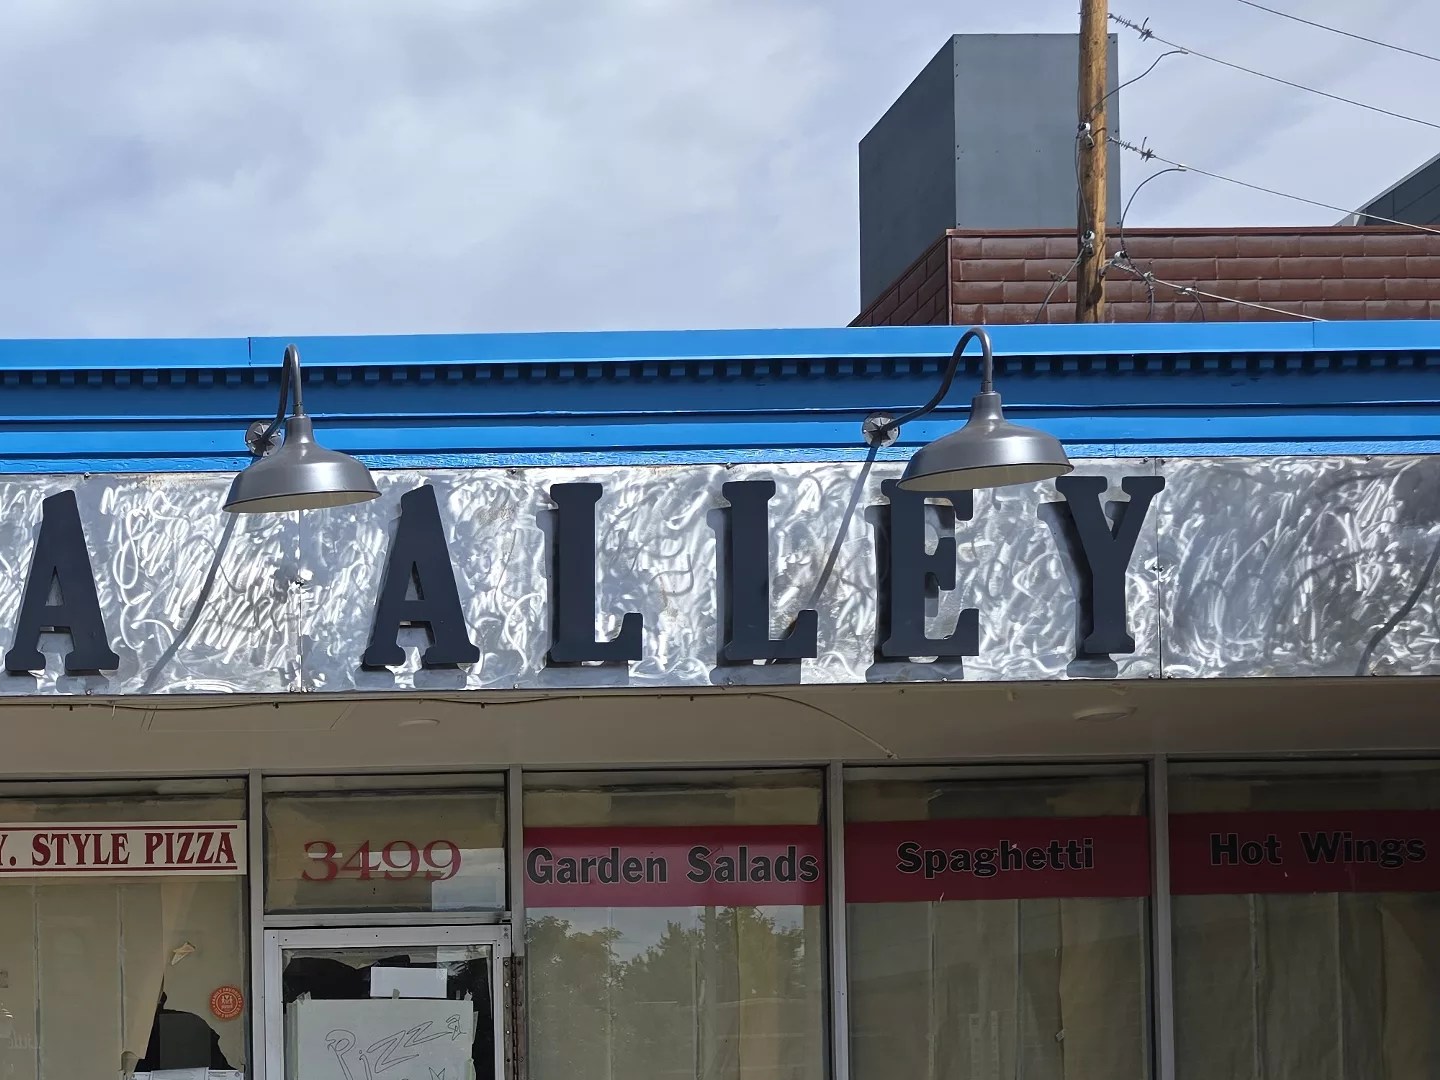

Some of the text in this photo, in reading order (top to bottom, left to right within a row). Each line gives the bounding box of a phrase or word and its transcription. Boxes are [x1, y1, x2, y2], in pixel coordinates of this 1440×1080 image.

[363, 475, 1167, 669] ALLEY
[31, 833, 131, 866] STYLE
[144, 832, 236, 864] PIZZA
[301, 839, 462, 883] 3499
[525, 845, 820, 885] Garden Salads
[895, 837, 1095, 879] Spaghetti
[1209, 831, 1427, 869] Hot Wings
